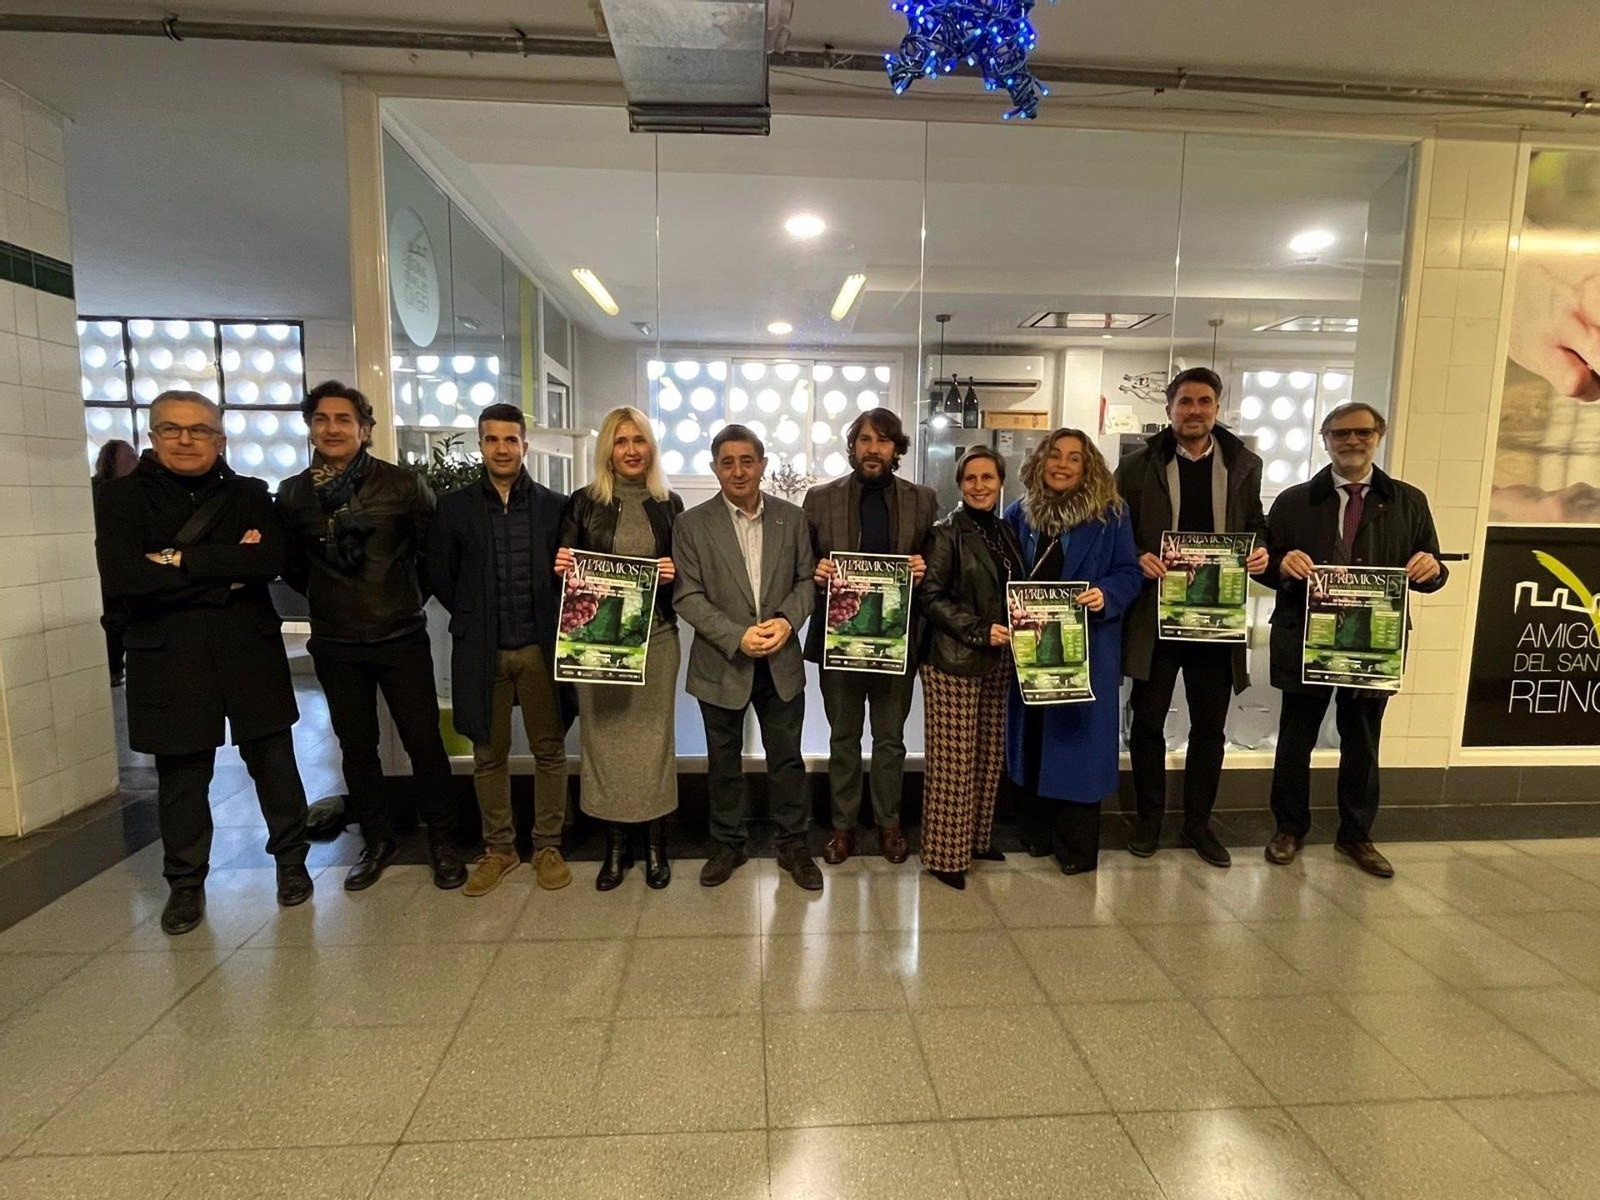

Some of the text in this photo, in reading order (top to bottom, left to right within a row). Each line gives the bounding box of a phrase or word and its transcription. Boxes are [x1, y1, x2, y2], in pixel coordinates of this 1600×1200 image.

[587, 559, 640, 576] PREMIOS
[848, 560, 895, 572] PREMIOS
[1329, 573, 1386, 586] PREMIOS
[1024, 588, 1070, 600] PREMIOS
[1514, 653, 1551, 673] DEL
[1508, 679, 1600, 714] REIN
